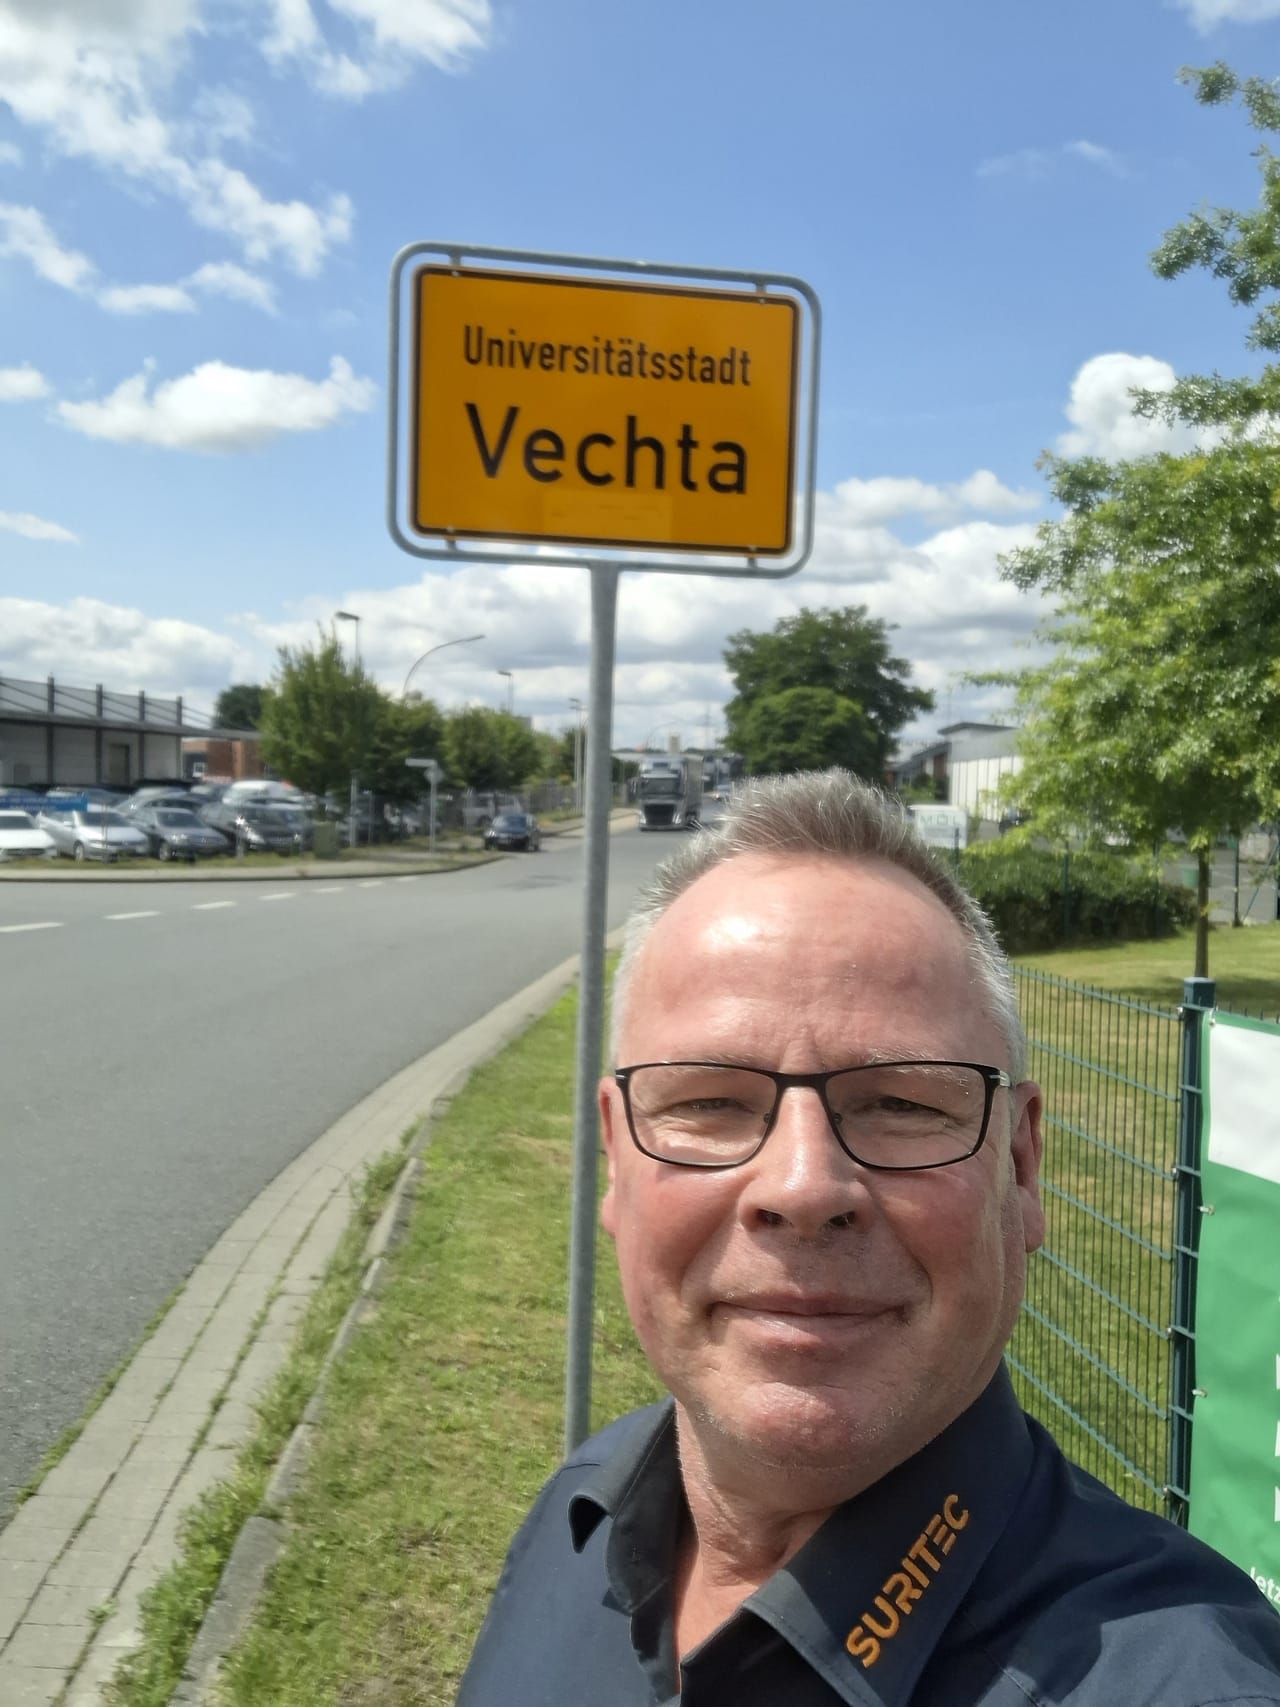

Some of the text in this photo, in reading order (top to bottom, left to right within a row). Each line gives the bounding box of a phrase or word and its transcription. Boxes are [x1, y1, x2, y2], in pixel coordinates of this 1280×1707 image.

[463, 325, 752, 386] Universitätsstadt
[465, 402, 748, 495] Vechta
[846, 1494, 969, 1669] SURITEC
